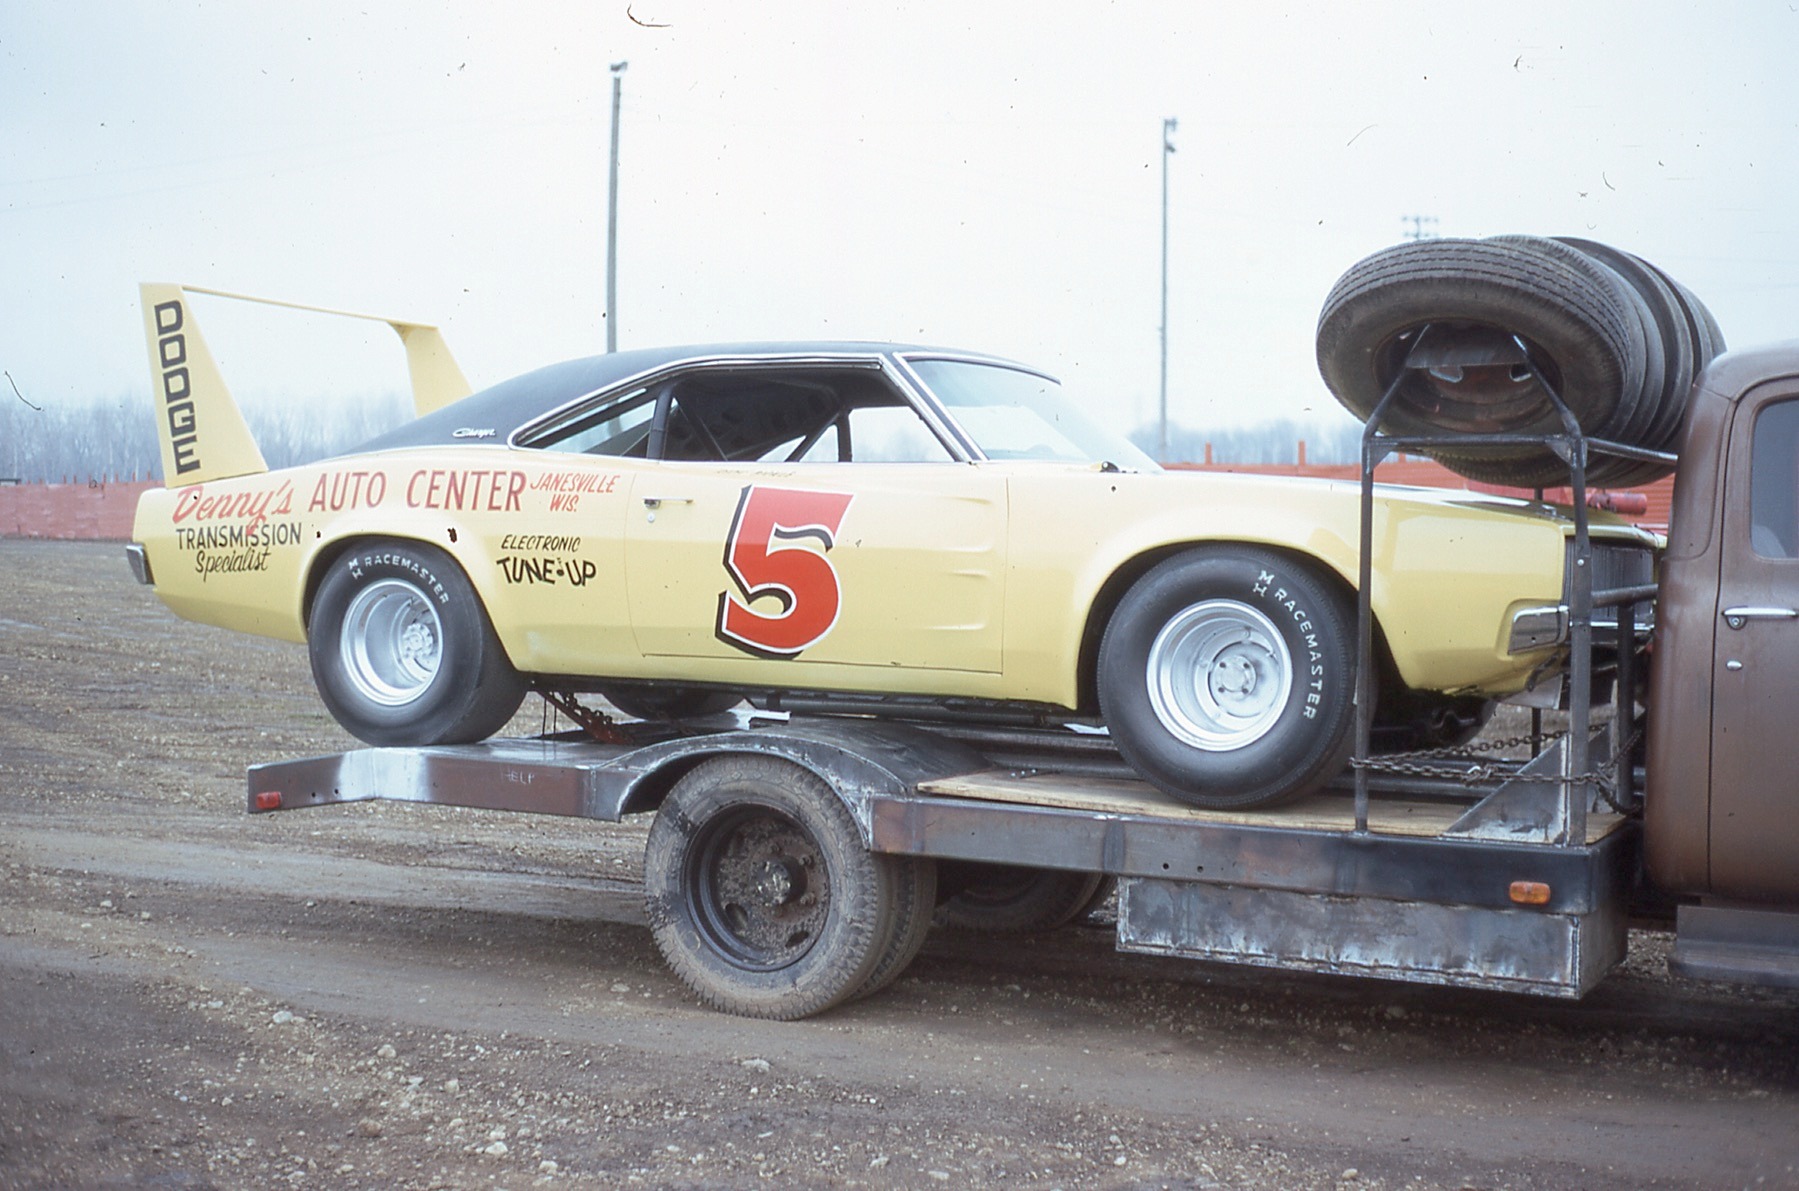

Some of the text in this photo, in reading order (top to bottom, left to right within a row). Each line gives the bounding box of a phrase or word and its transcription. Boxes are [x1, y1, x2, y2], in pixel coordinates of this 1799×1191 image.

[154, 299, 201, 476] DODGE
[172, 469, 527, 536] Denny's AUTO CENTER
[530, 472, 621, 493] JANESVILLE
[176, 522, 302, 551] TRANSMISSION
[501, 534, 581, 552] ELECTRONIC
[195, 545, 271, 582] Specialist
[364, 554, 449, 604] RACEMASTER
[715, 484, 855, 661] 5
[1274, 588, 1323, 719] RACEMASTER
